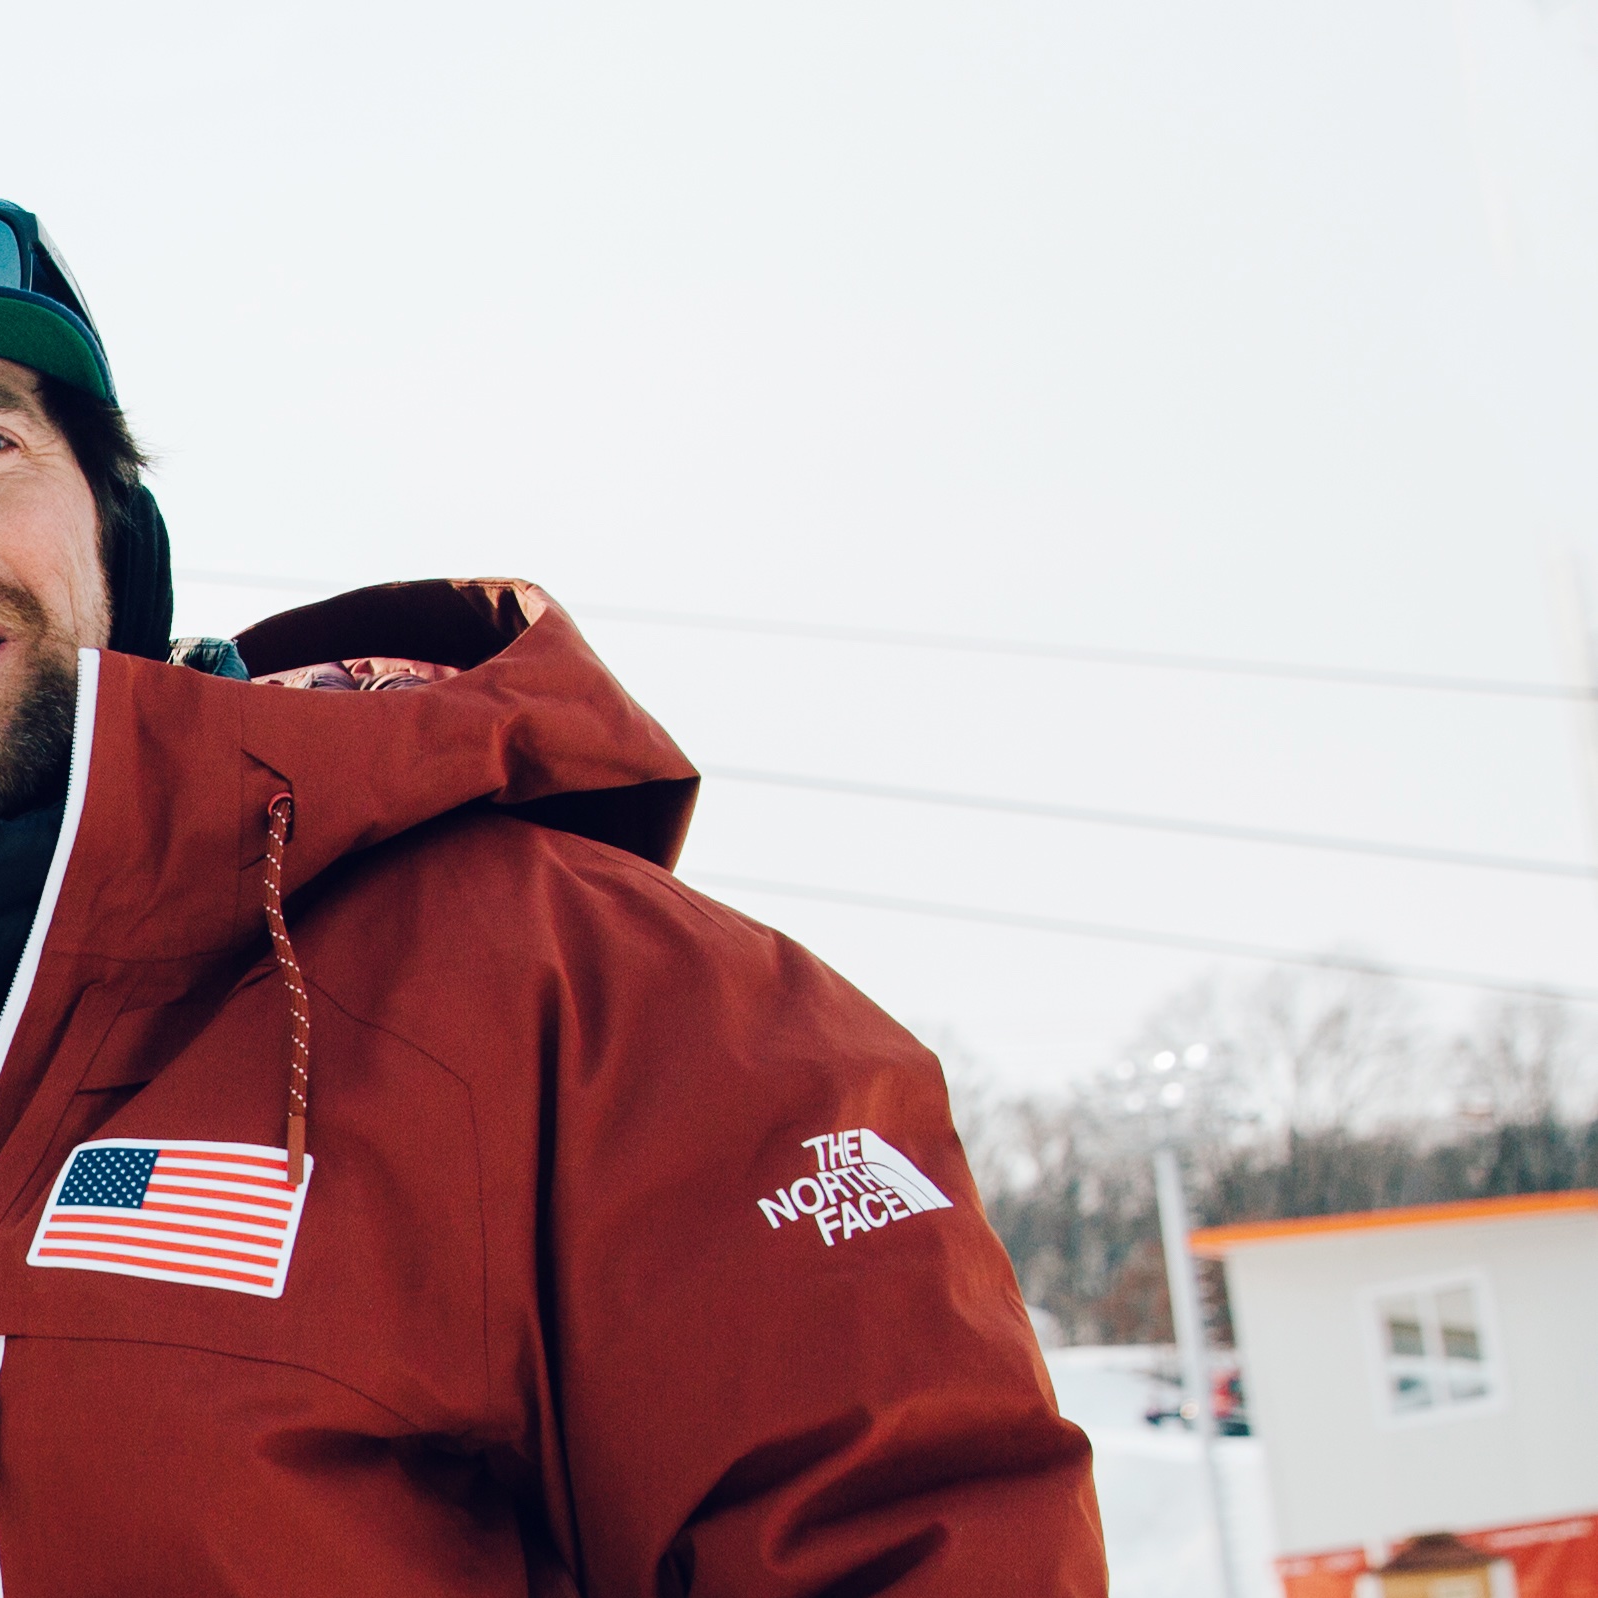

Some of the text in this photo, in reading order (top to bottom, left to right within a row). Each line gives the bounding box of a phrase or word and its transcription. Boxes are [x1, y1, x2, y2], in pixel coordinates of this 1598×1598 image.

[801, 1128, 864, 1172] THE
[757, 1163, 888, 1230] NORTH
[814, 1187, 912, 1247] FACE
